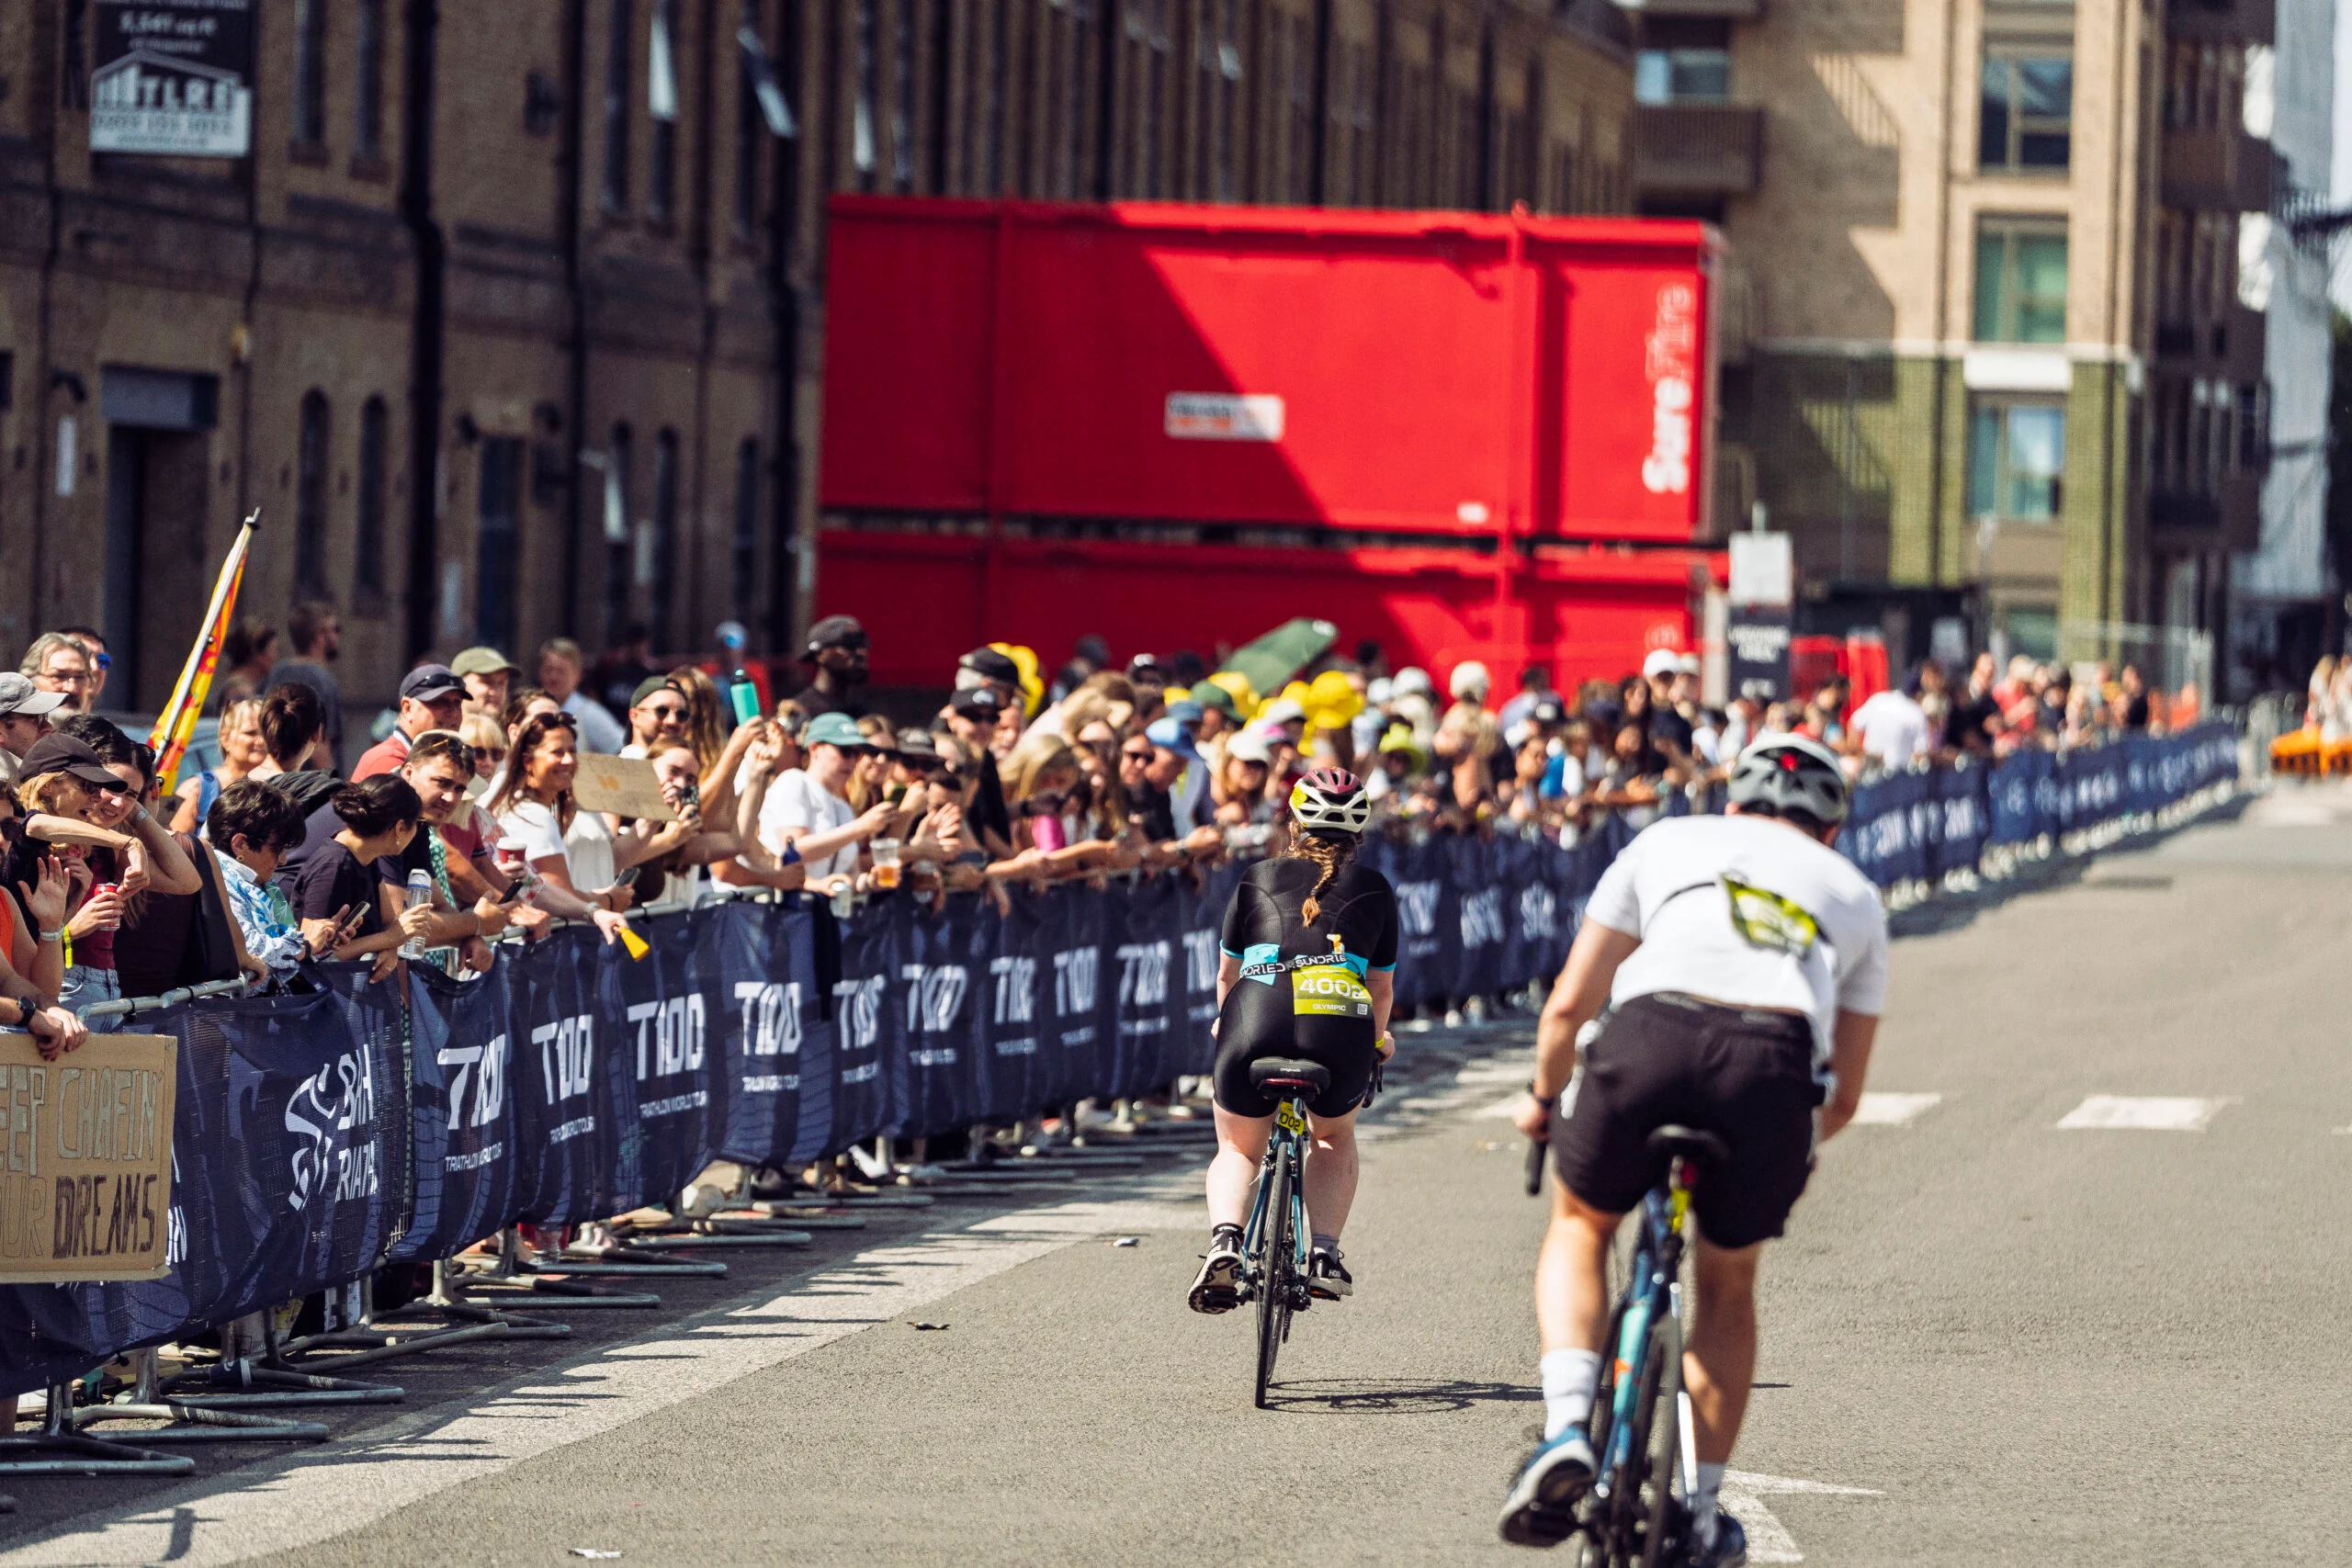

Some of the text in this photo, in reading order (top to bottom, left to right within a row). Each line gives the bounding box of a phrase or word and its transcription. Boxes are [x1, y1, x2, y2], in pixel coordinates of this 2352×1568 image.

[1298, 977, 1368, 999] 4002
[1312, 1002, 1347, 1012] OLYMPIC
[531, 1014, 593, 1106] T100
[628, 992, 706, 1081] T100
[52, 1173, 158, 1259] DREAMS
